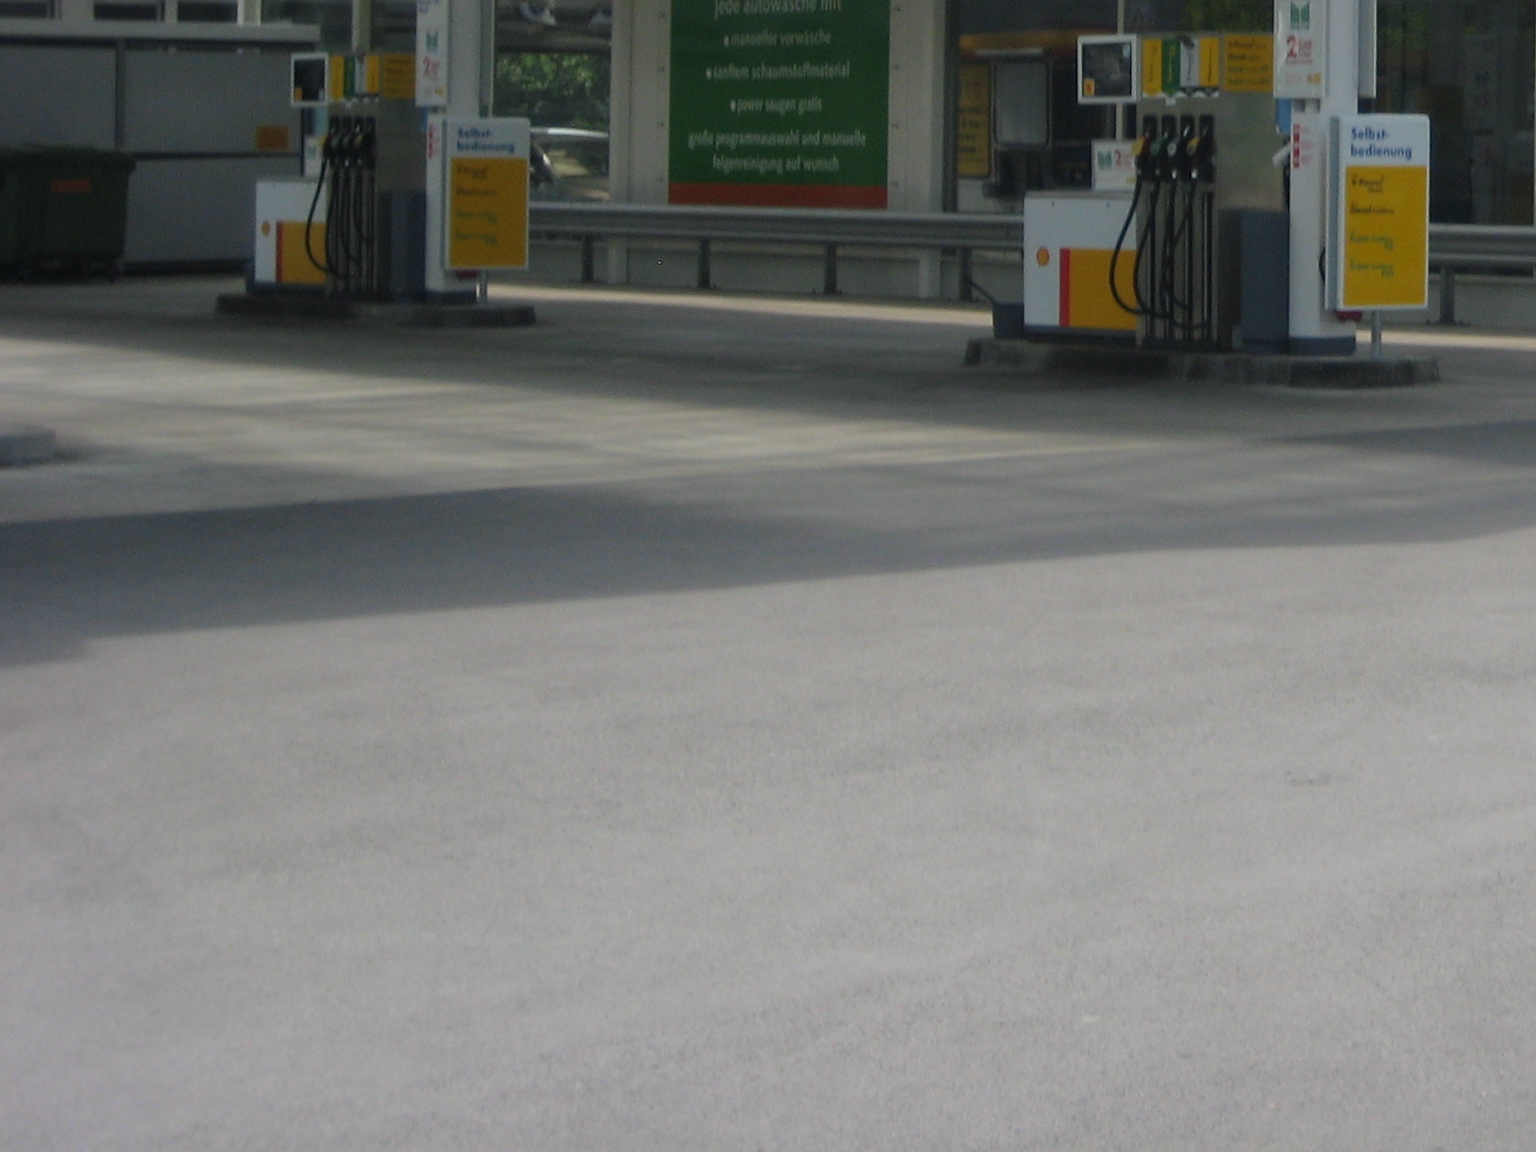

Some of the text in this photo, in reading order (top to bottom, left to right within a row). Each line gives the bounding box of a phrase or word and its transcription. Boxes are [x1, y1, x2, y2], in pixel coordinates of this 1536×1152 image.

[1286, 34, 1298, 58] 2
[765, 98, 796, 115] saugen
[801, 129, 820, 146] und
[1350, 126, 1388, 140] Selbst-
[1350, 143, 1412, 160] bedienung
